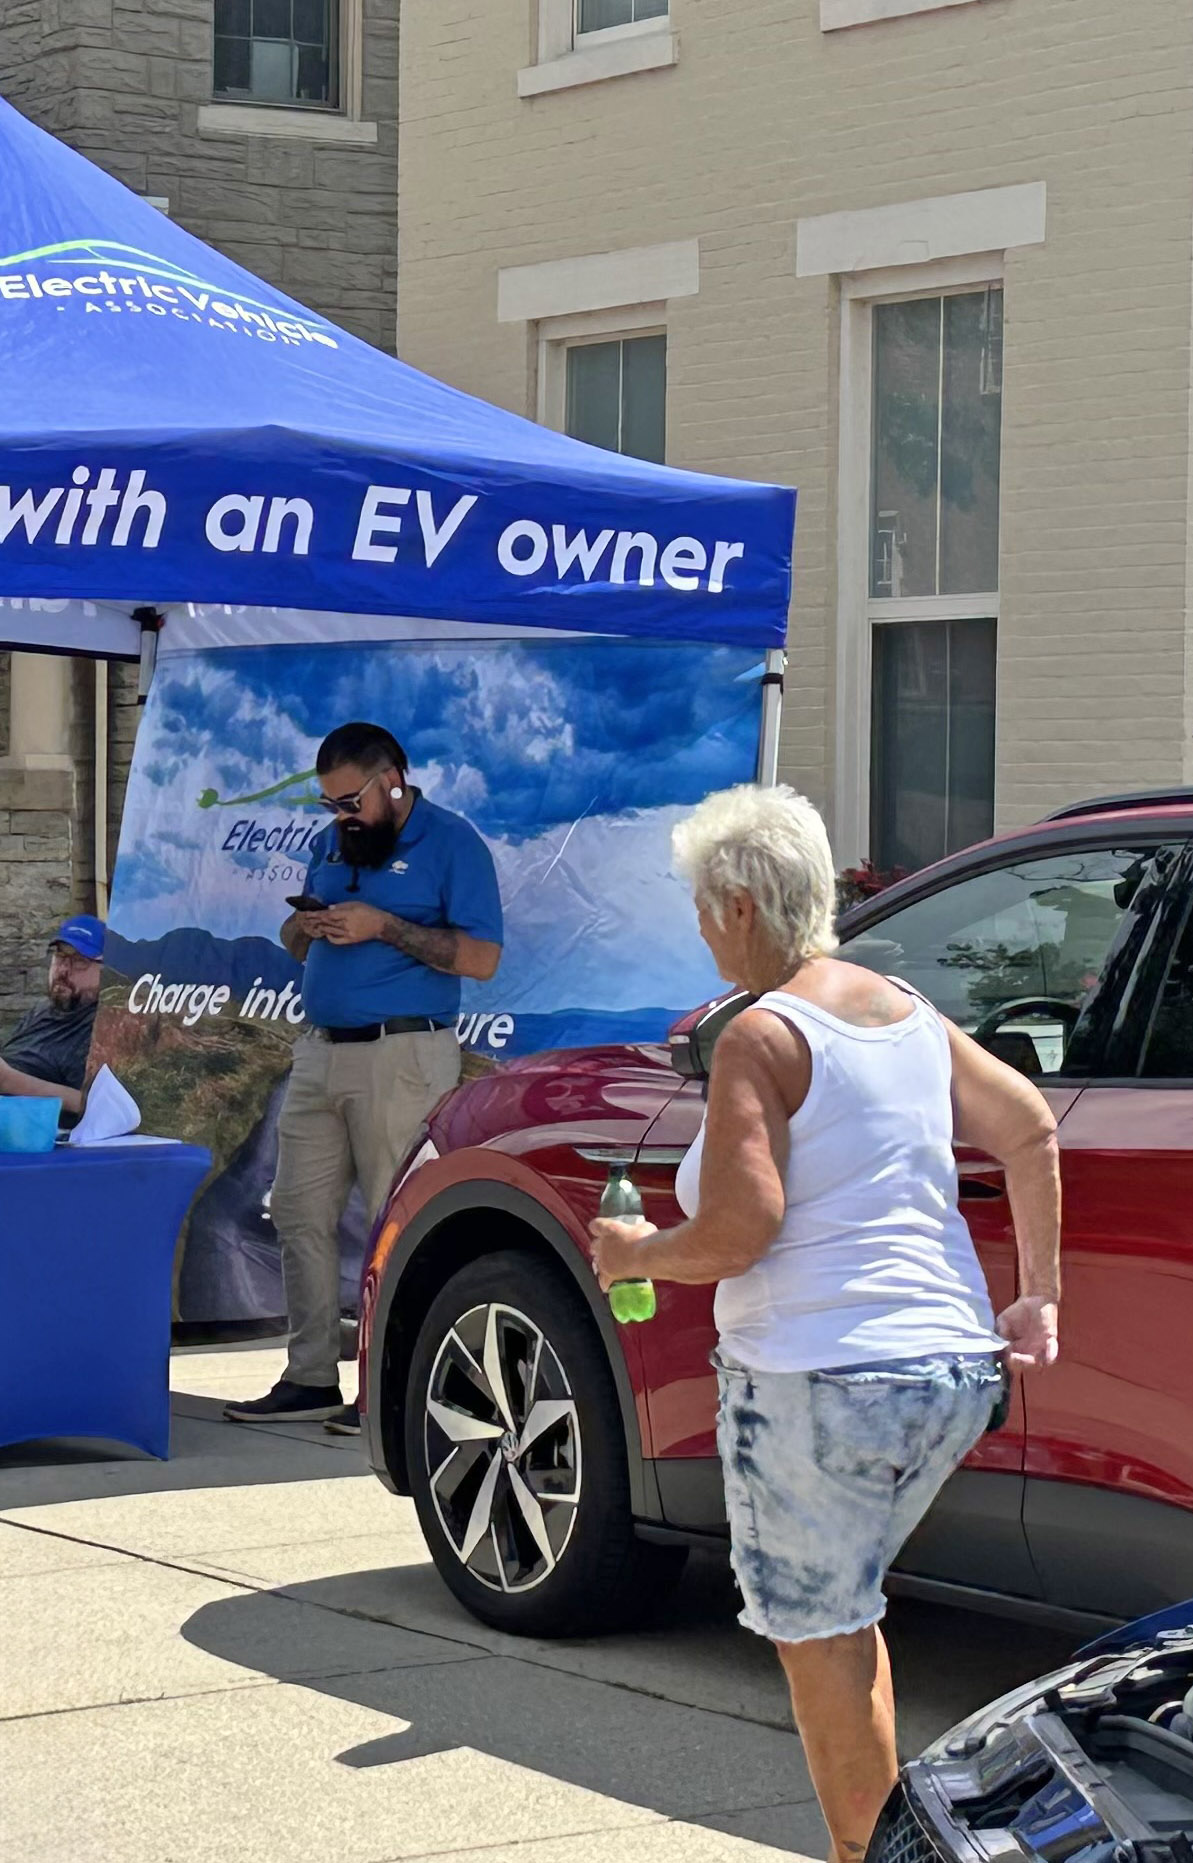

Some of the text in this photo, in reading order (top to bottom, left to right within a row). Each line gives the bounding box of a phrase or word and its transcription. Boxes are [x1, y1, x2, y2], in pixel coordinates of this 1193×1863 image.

[85, 301, 300, 346] ASSOCIATION
[177, 286, 338, 349] Vehicle
[206, 494, 314, 555] an
[352, 485, 478, 568] EV
[498, 519, 744, 593] owner
[221, 819, 318, 852] Electri
[128, 973, 230, 1026] Charge
[456, 1012, 514, 1049] ure
